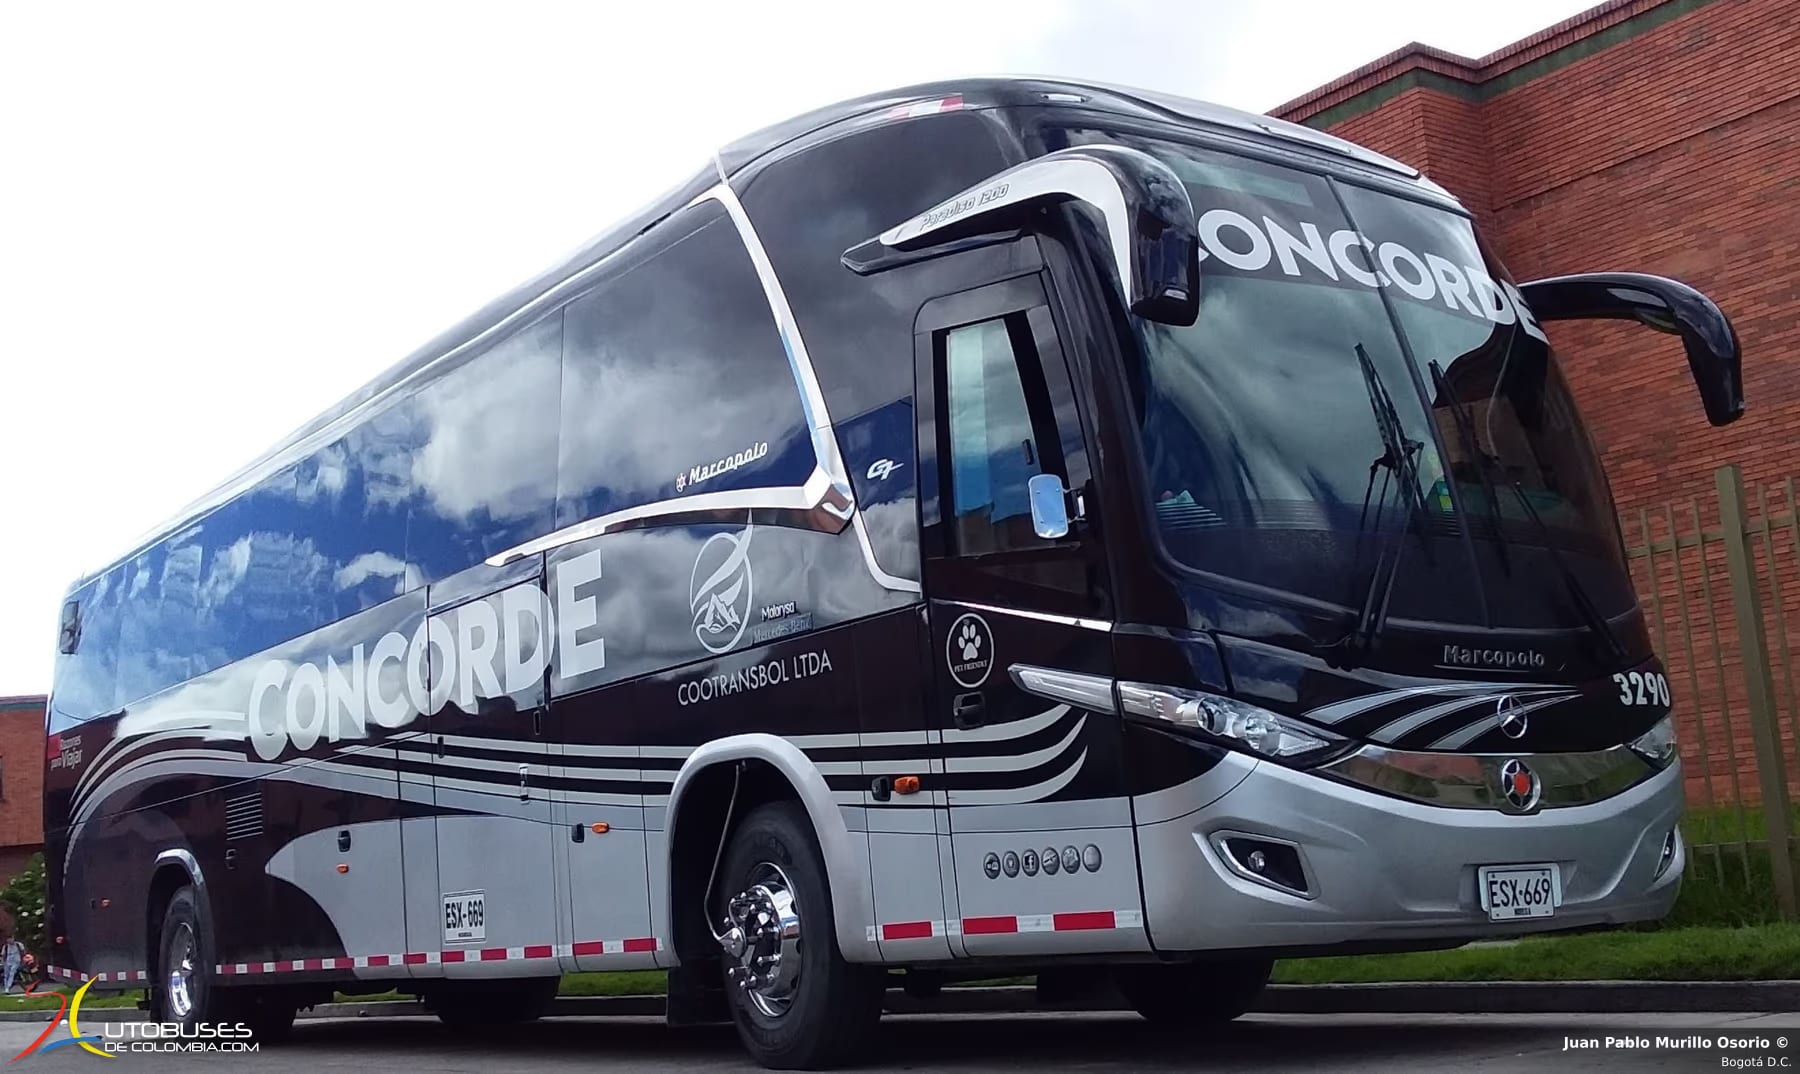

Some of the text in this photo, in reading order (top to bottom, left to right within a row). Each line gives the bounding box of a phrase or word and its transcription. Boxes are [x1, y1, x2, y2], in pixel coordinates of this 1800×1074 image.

[920, 183, 1010, 231] Paradiso 1200
[1198, 208, 1550, 345] ONCORDE
[688, 441, 769, 486] Marcopolo
[249, 548, 605, 761] CONCORDE
[677, 648, 833, 706] COOTRANSBOL LTDA
[1443, 644, 1545, 668] Marcopolo
[1612, 671, 1671, 708] 3290
